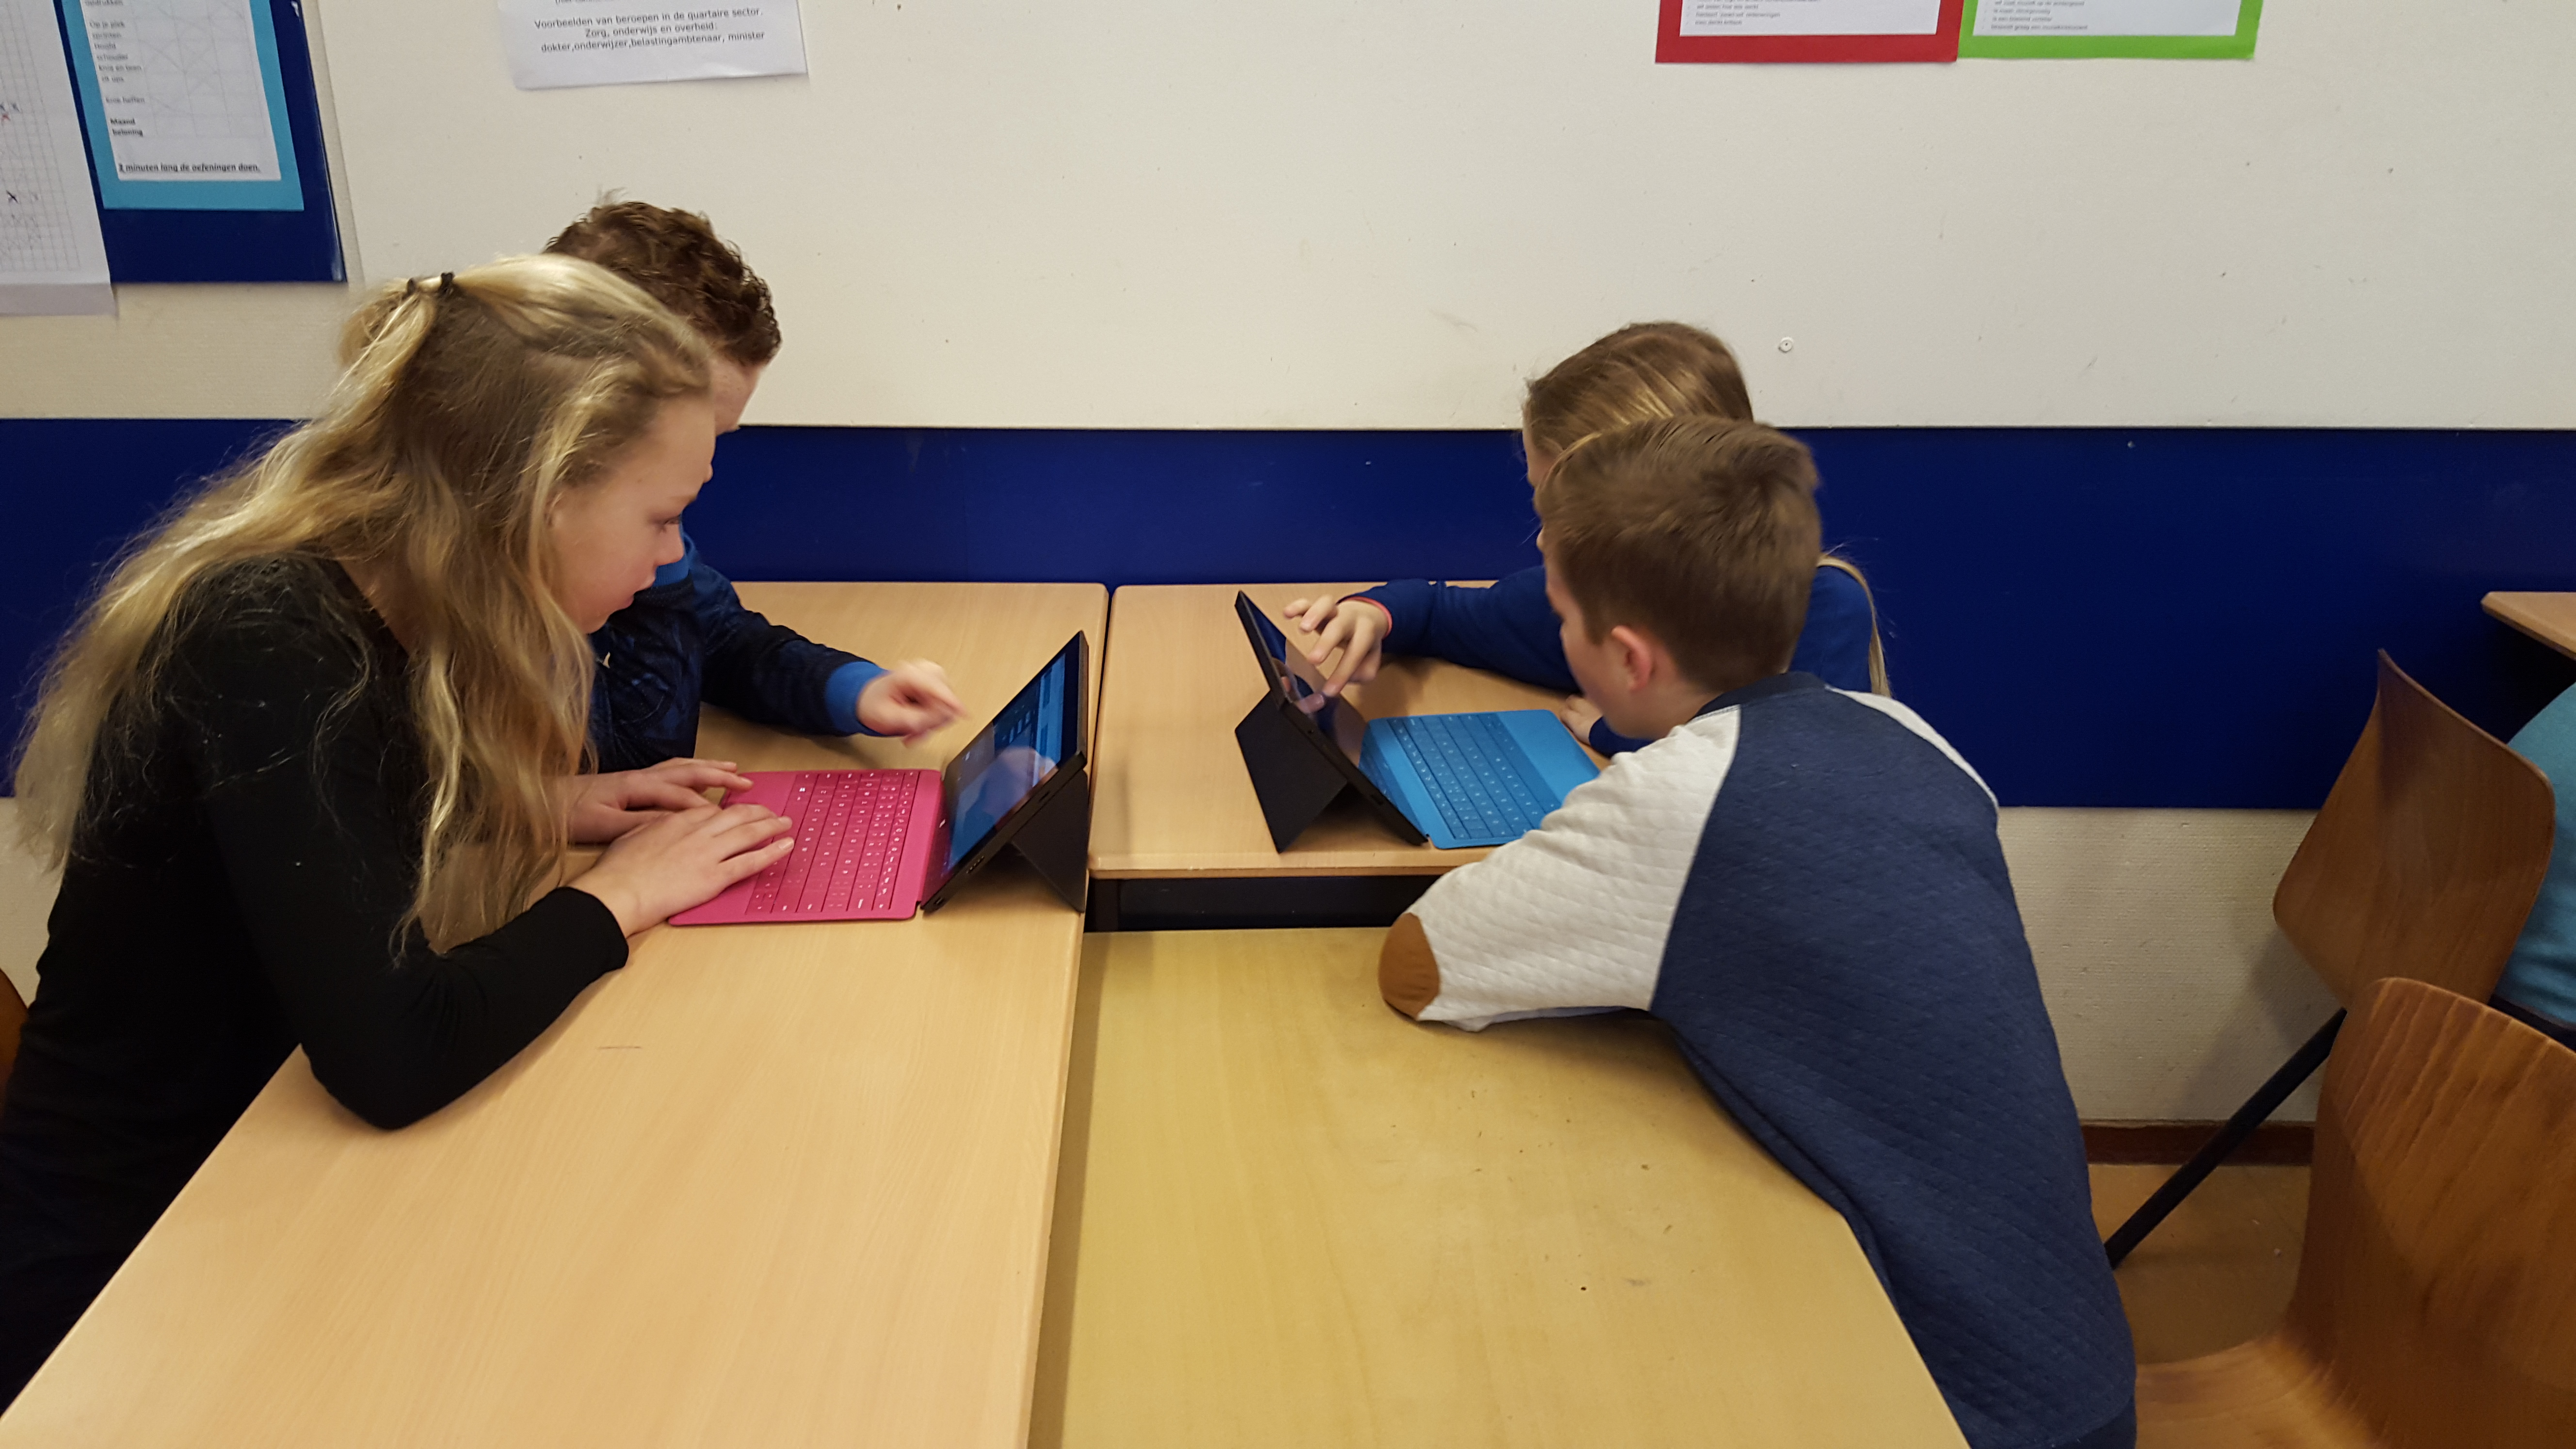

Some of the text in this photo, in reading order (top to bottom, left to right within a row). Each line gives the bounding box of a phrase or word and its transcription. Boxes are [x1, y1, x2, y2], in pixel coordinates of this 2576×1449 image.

[534, 17, 593, 29] Voorbeelden
[596, 16, 613, 25] van
[615, 14, 659, 24] beroepen
[674, 11, 685, 20] de
[687, 9, 729, 20] quartaire
[612, 25, 658, 36] onderwijs
[660, 25, 672, 33] en
[728, 31, 765, 41] minister
[125, 162, 159, 172] minuten
[160, 162, 178, 172] lang
[180, 163, 190, 172] de
[192, 162, 236, 172] oefeningen
